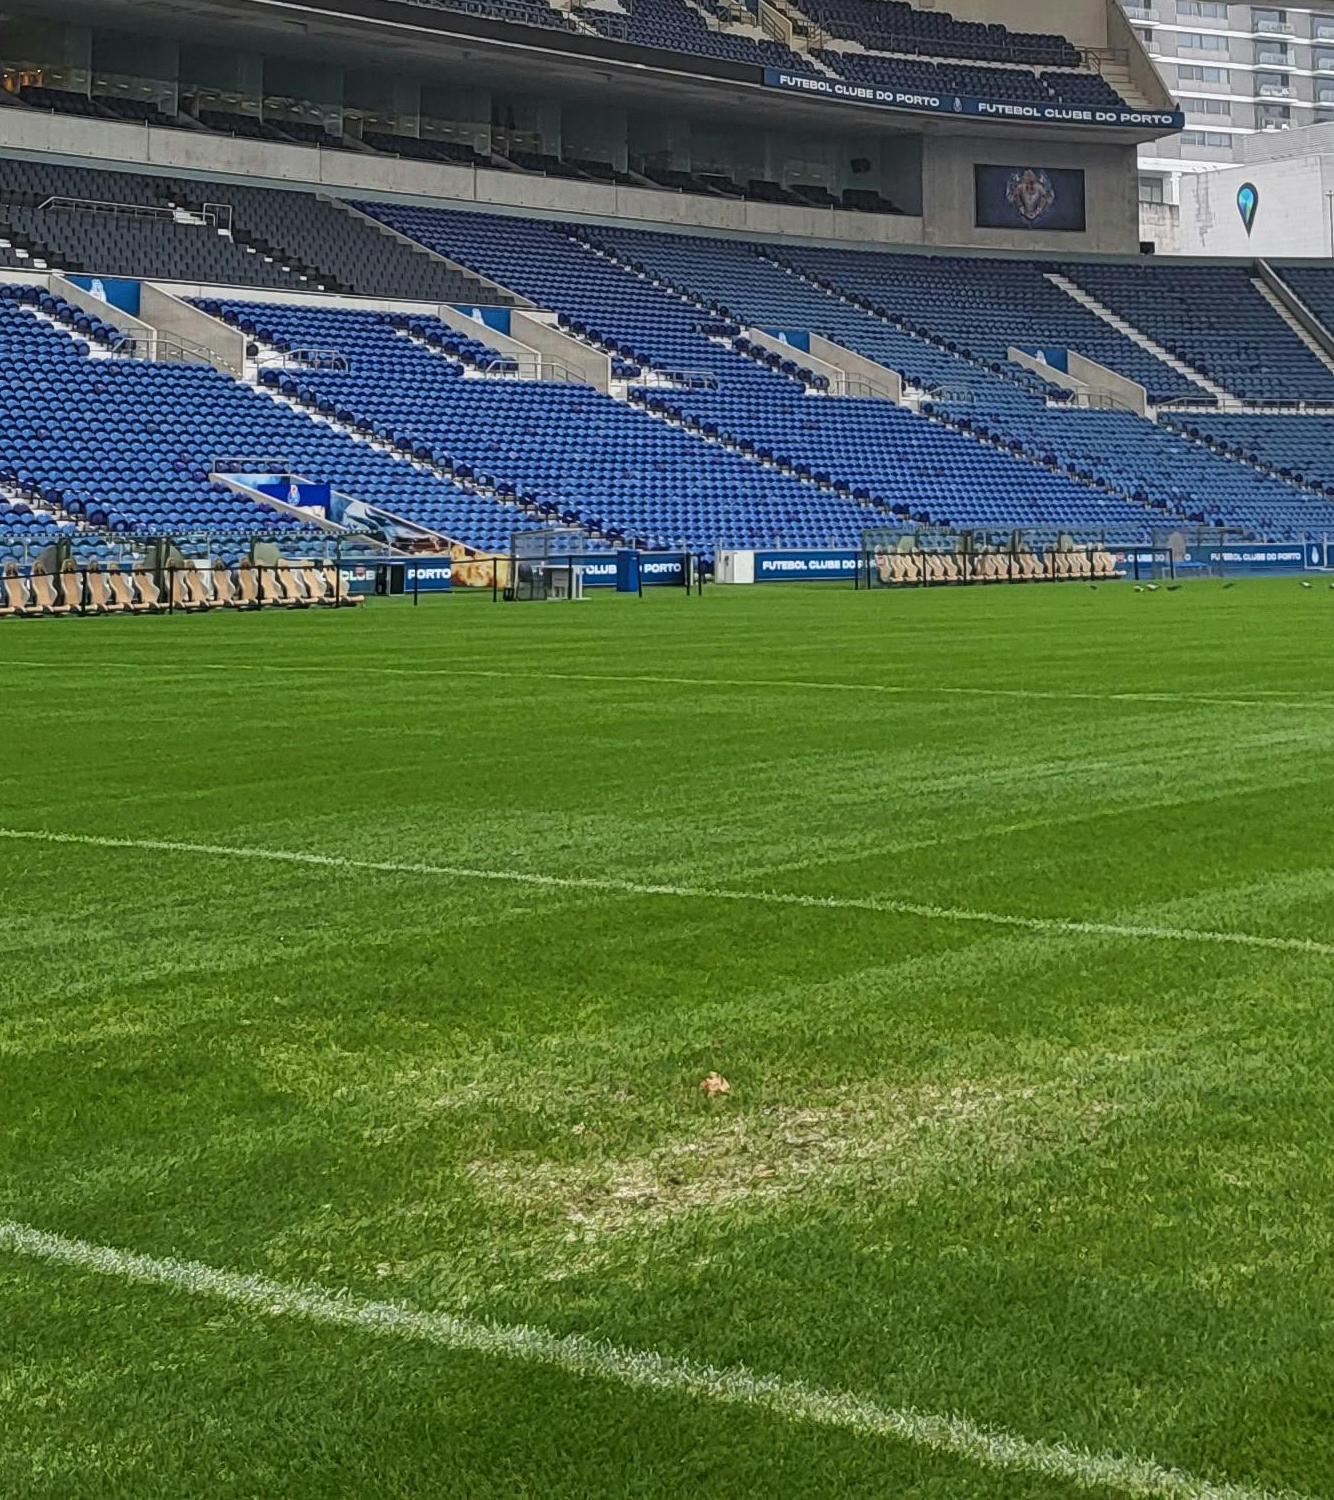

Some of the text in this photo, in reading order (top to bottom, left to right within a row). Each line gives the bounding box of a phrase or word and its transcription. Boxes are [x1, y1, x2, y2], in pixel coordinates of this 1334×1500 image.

[779, 75, 940, 107] FUTEBOL CLUBE DO PORTO
[978, 102, 1173, 125] FUTEBOL CLUBE DO PORTO
[585, 562, 682, 575] CLUB PORTO
[762, 560, 807, 571] FUTEBOL
[808, 560, 841, 570] CLUBE
[842, 560, 856, 570] DO
[407, 568, 452, 580] PORTO
